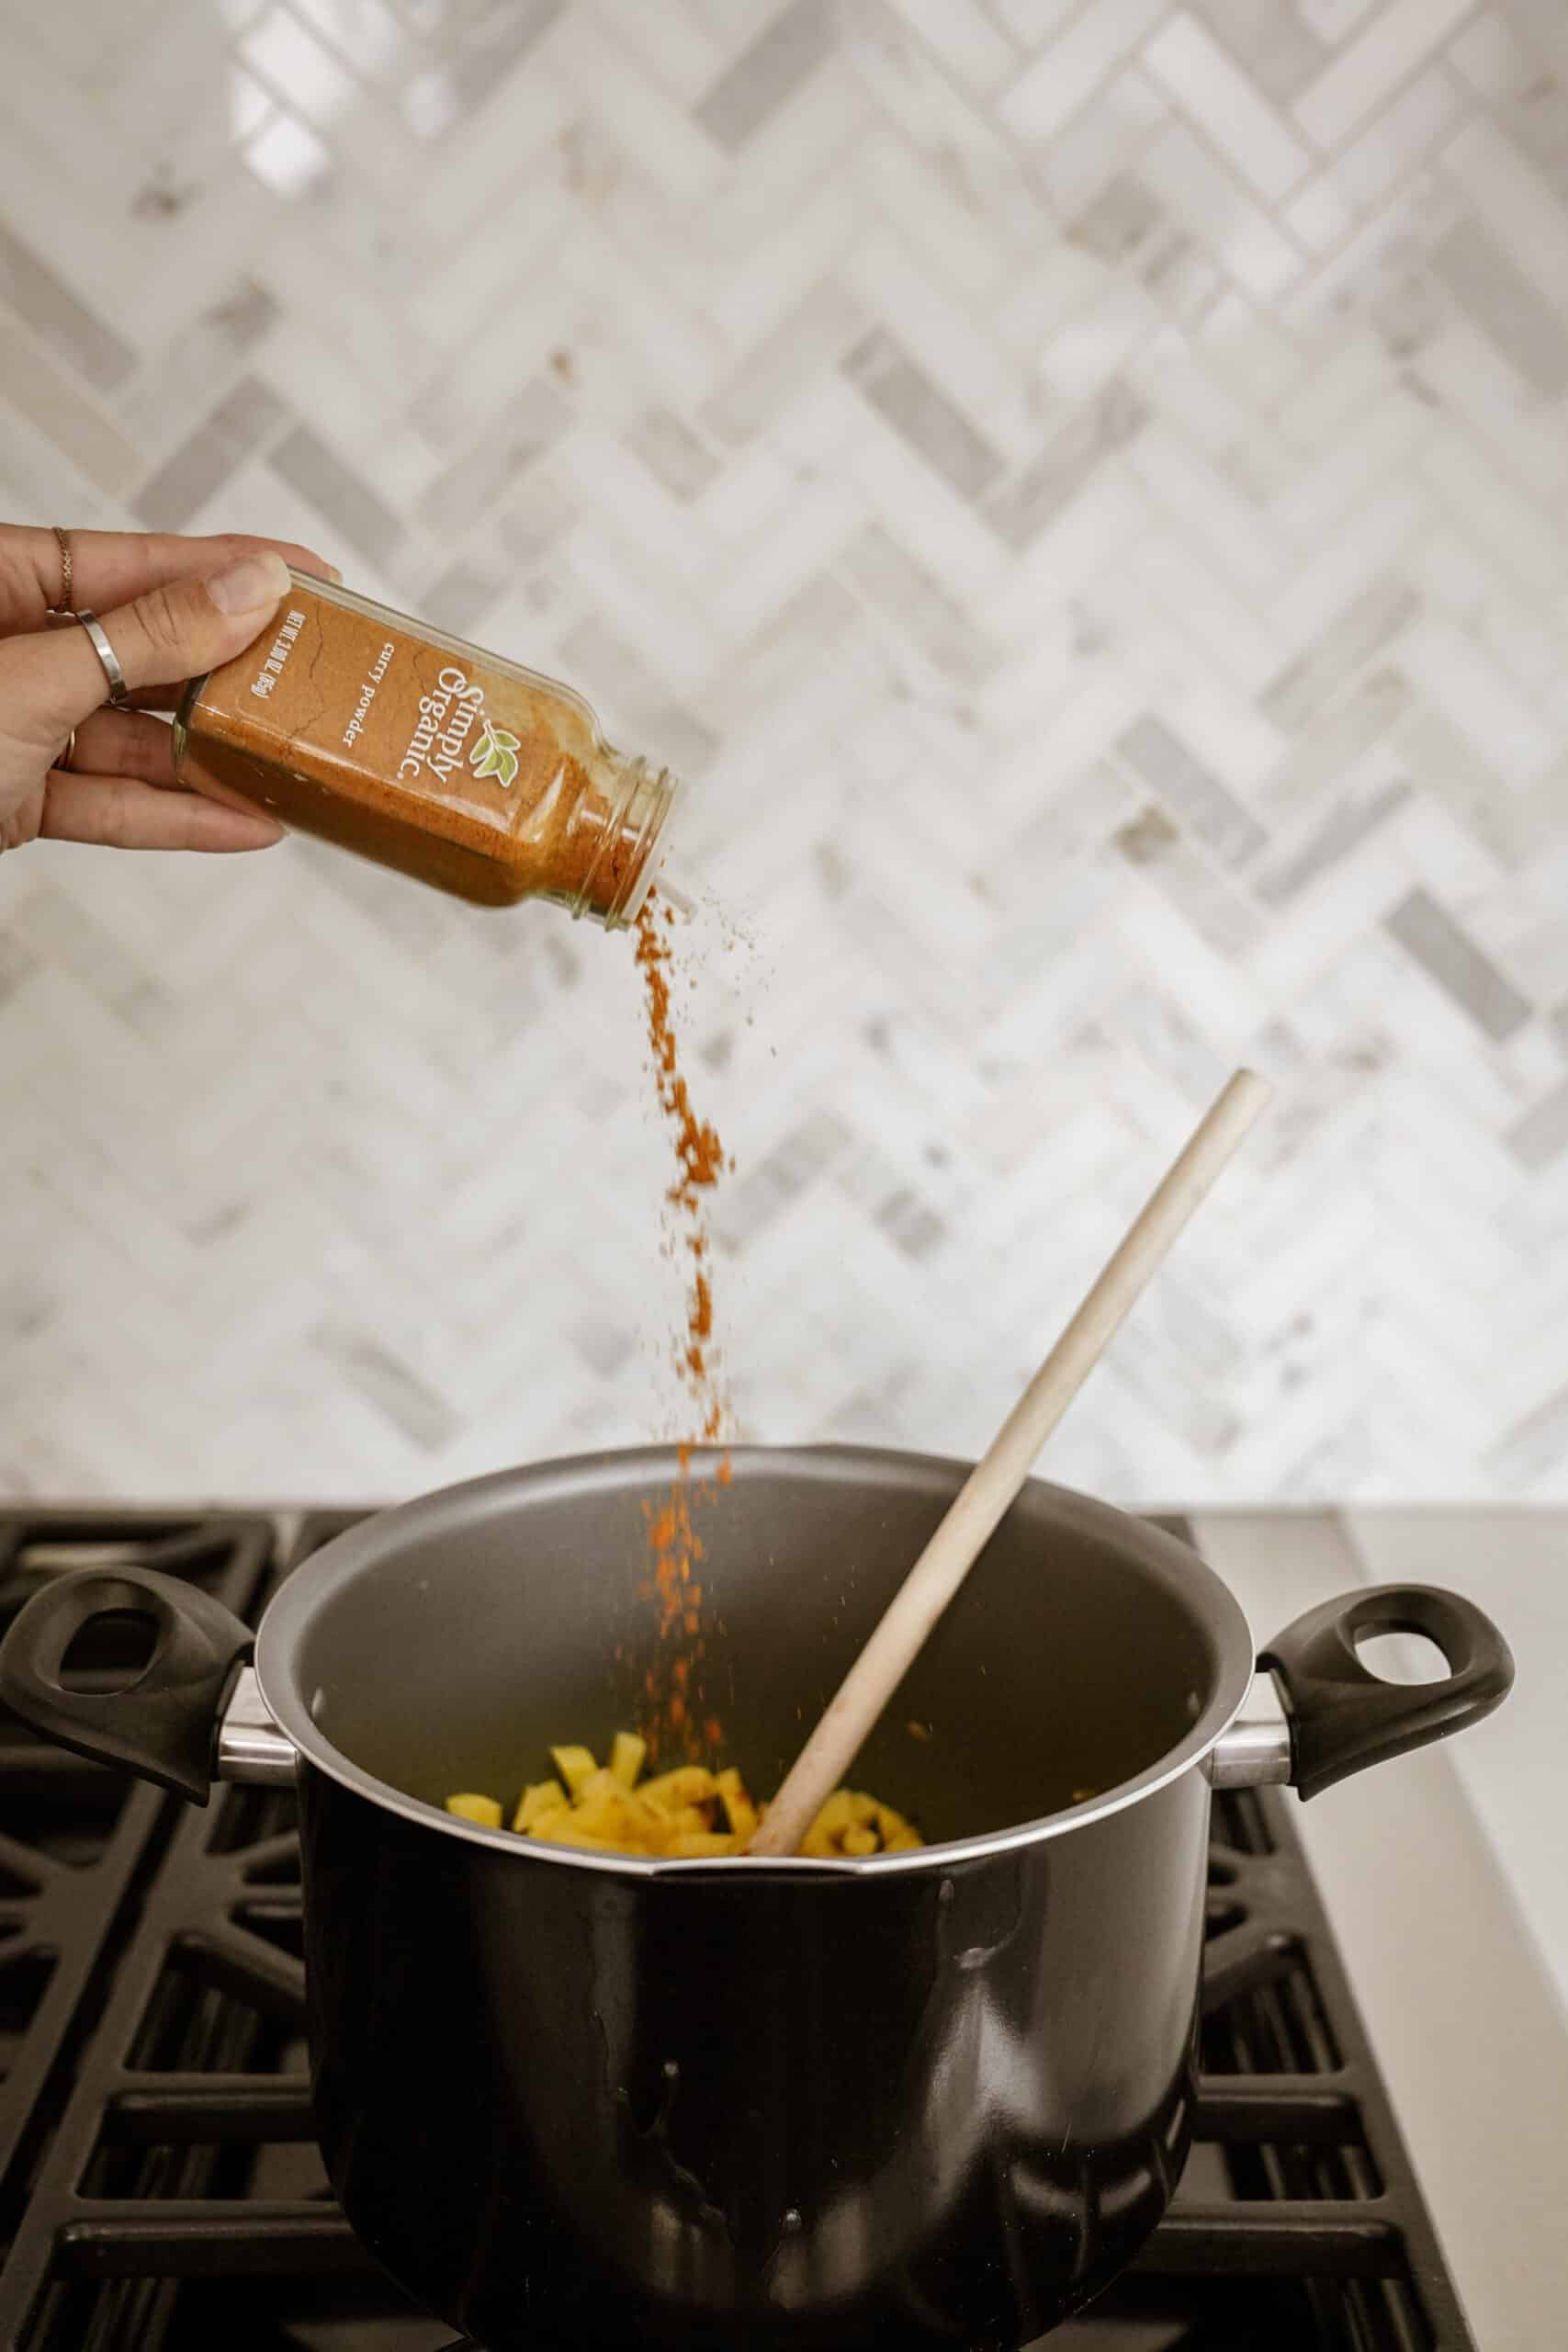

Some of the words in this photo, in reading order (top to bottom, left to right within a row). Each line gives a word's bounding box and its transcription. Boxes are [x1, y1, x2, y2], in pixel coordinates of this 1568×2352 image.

[287, 610, 306, 629] NET
[265, 658, 283, 674] OZ
[367, 642, 395, 684] curry
[343, 684, 375, 748] powder
[426, 684, 485, 783] Simply
